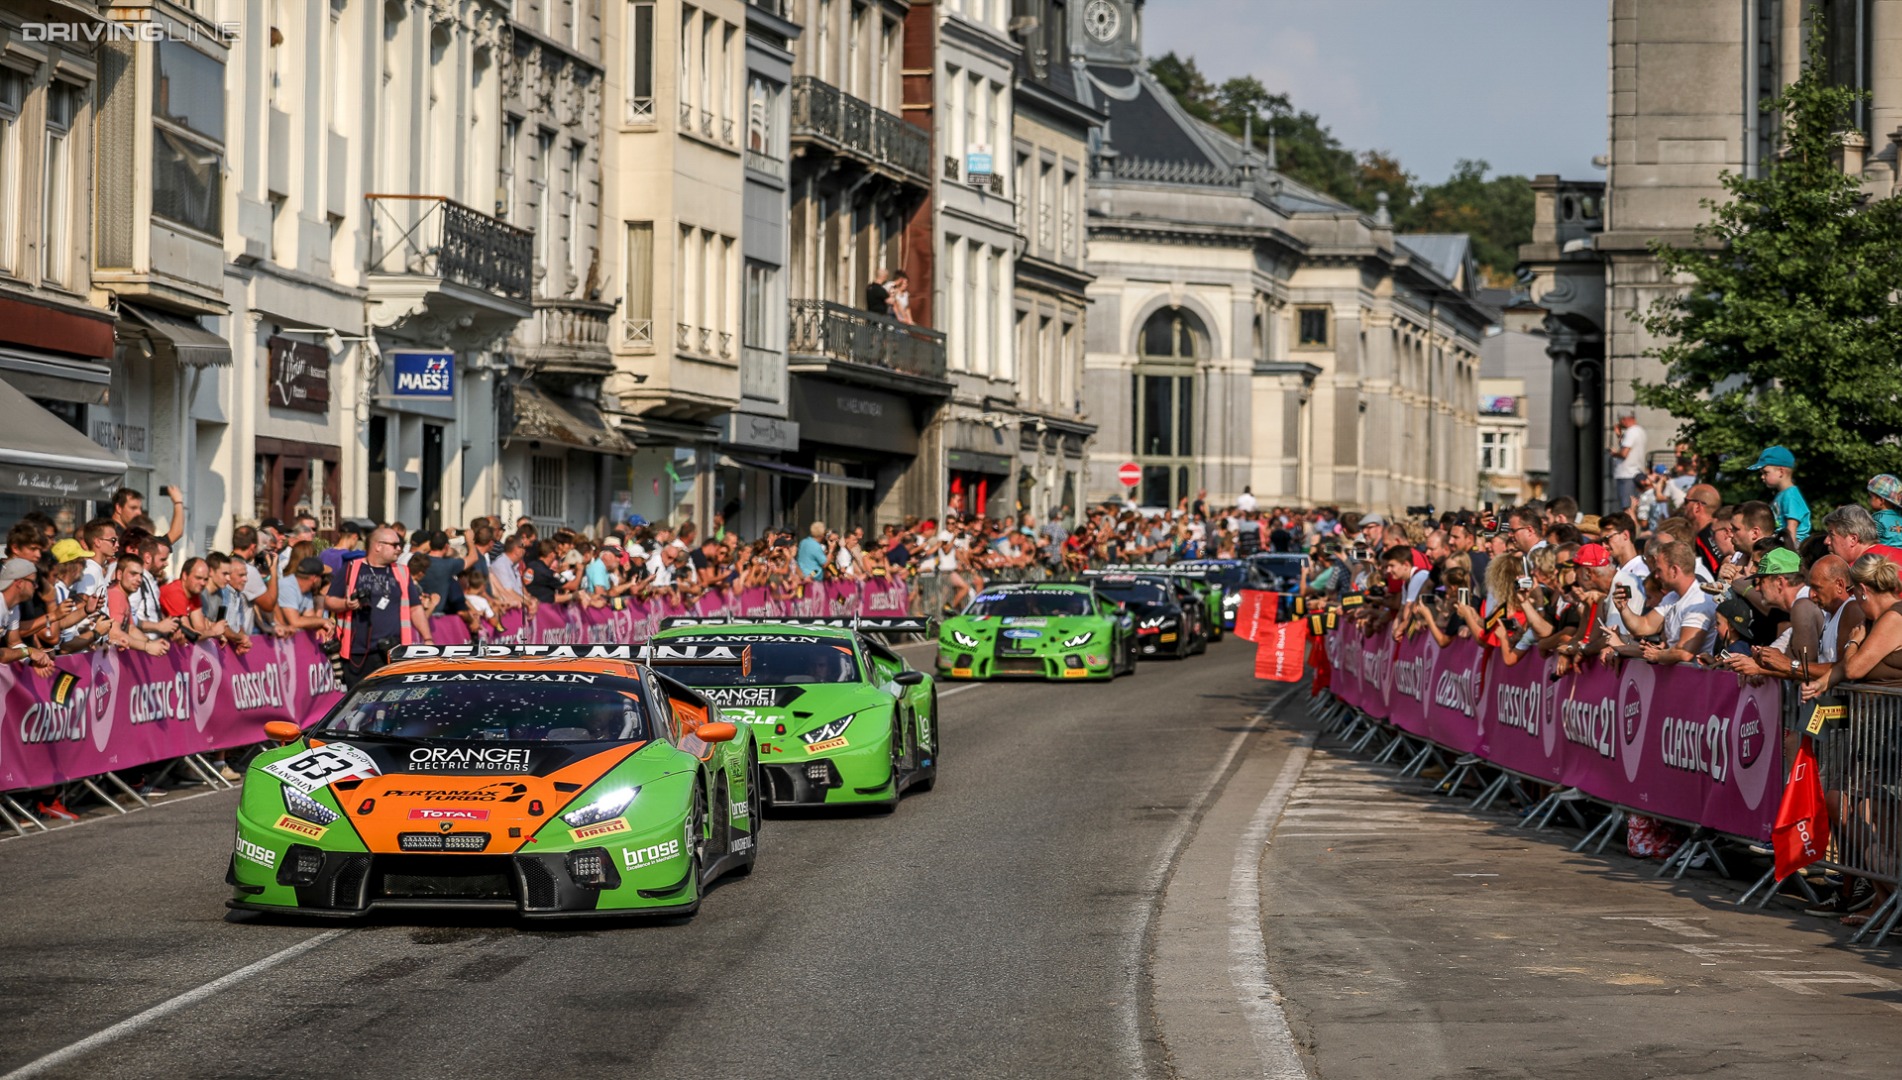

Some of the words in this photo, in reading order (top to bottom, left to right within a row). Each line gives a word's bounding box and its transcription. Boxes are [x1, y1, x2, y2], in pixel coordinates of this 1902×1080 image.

[398, 372, 441, 391] MAES
[675, 634, 820, 644] BLANCPAIN
[402, 645, 738, 660] PERTAMINA
[232, 671, 268, 710] CLASSIC
[265, 662, 283, 708] 21
[402, 672, 598, 684] BLANCPAIN
[130, 680, 174, 724] CLASSIC
[175, 671, 190, 720] 21
[1436, 669, 1465, 711] CLASSIC
[21, 699, 75, 743] CLASSIC
[71, 687, 90, 740] 21
[1498, 682, 1528, 729] CLASSIC
[1527, 681, 1541, 736] 21
[1624, 701, 1640, 718] CLASSIC
[1561, 698, 1599, 749] CLASSIC
[1599, 697, 1615, 758] 21
[1627, 718, 1632, 735] 21
[1740, 719, 1759, 738] CLASSIC
[810, 738, 845, 752] PIRELLI
[1661, 716, 1708, 773] CLASSIC
[1706, 714, 1730, 782] 21
[1742, 739, 1750, 758] 21
[288, 751, 353, 780] 63
[409, 747, 531, 764] ORANGE1
[409, 761, 469, 771] ELECTRIC
[475, 761, 529, 772] MOTORS
[265, 764, 316, 792] BLANCPAIN
[420, 809, 478, 819] TOTAL
[279, 817, 322, 837] PIRELLI
[575, 819, 625, 839] PIRELLI
[236, 831, 276, 864] brose
[622, 838, 679, 866] brose
